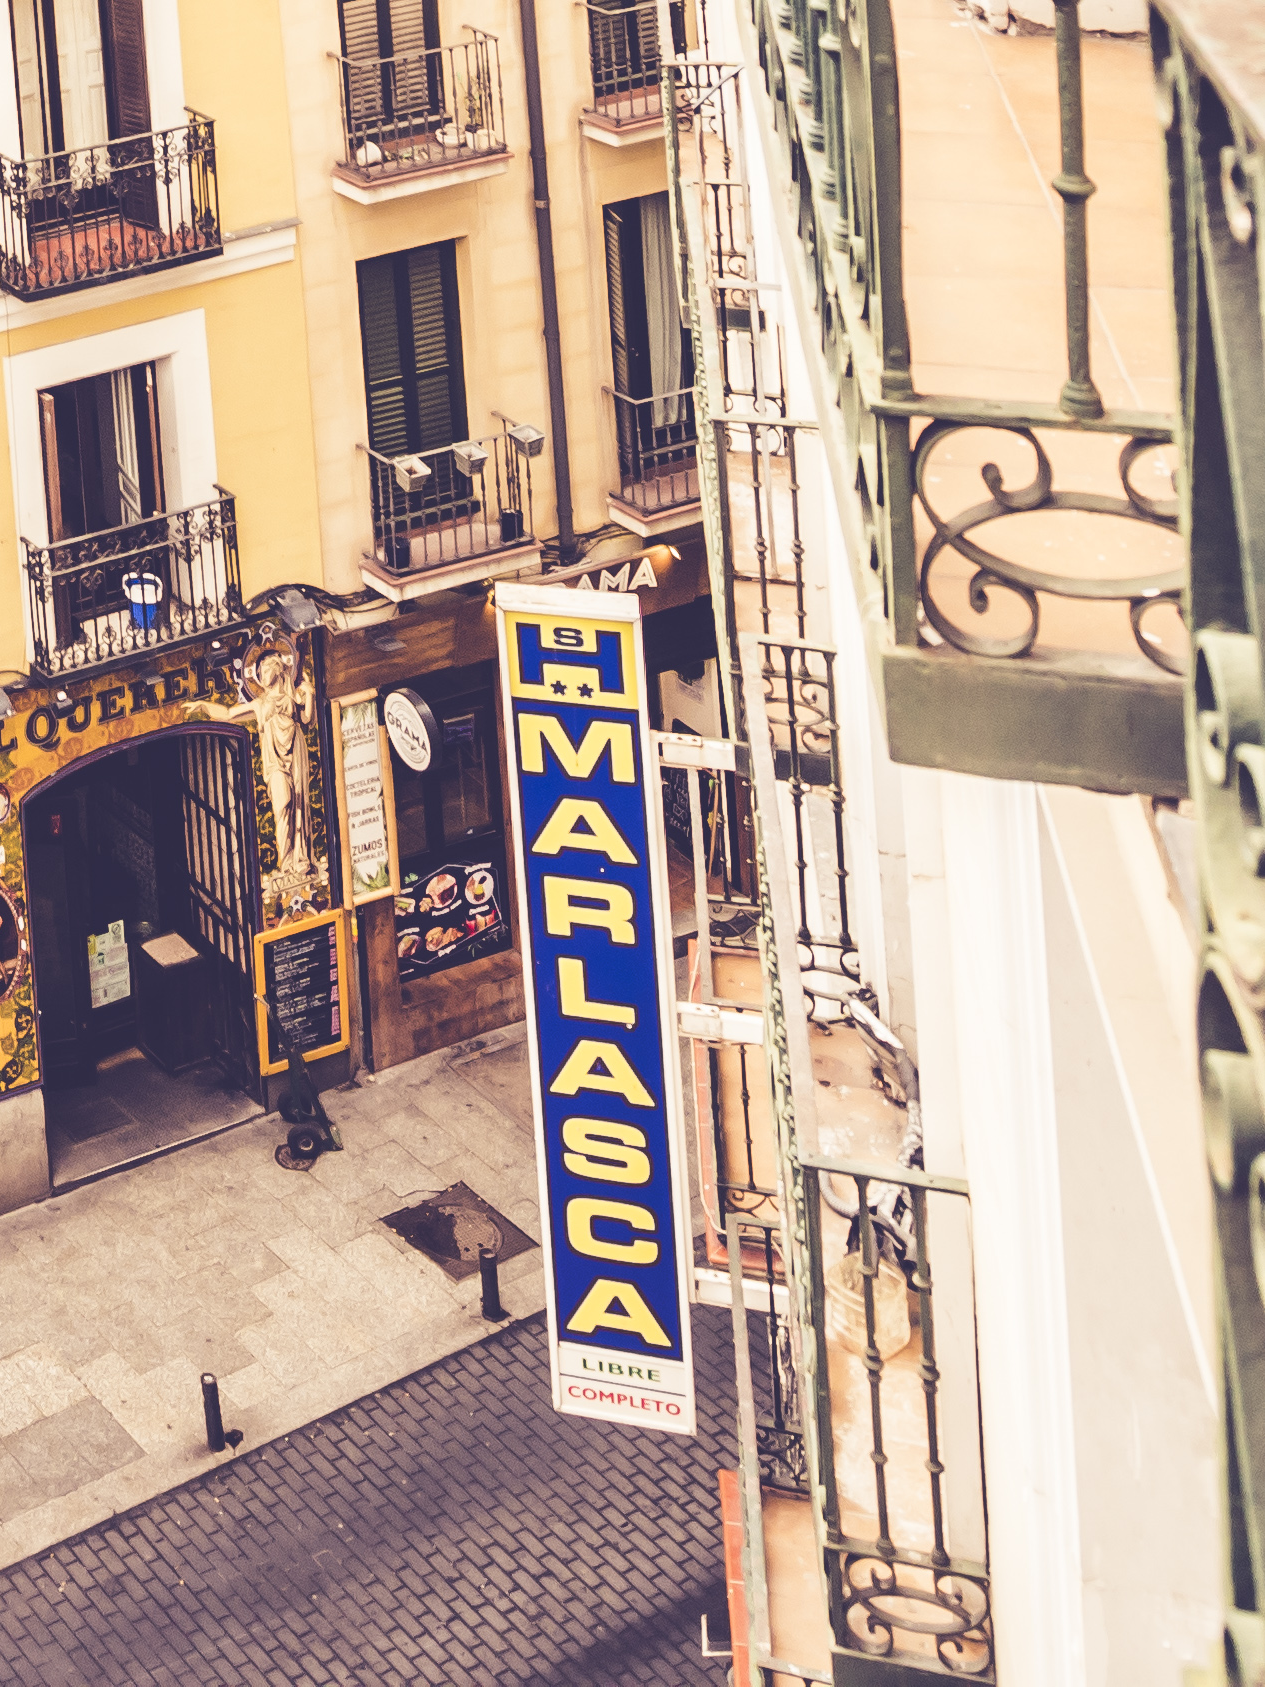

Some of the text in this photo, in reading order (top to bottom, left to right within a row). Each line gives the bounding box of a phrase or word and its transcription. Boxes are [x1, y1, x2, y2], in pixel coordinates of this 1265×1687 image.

[546, 557, 658, 592] AMA
[387, 711, 428, 756] GRAMA
[351, 838, 383, 857] ZUMOS
[517, 712, 673, 1348] MARLASCA
[581, 1357, 661, 1384] LIBRE
[567, 1385, 681, 1417] COMPLETO
